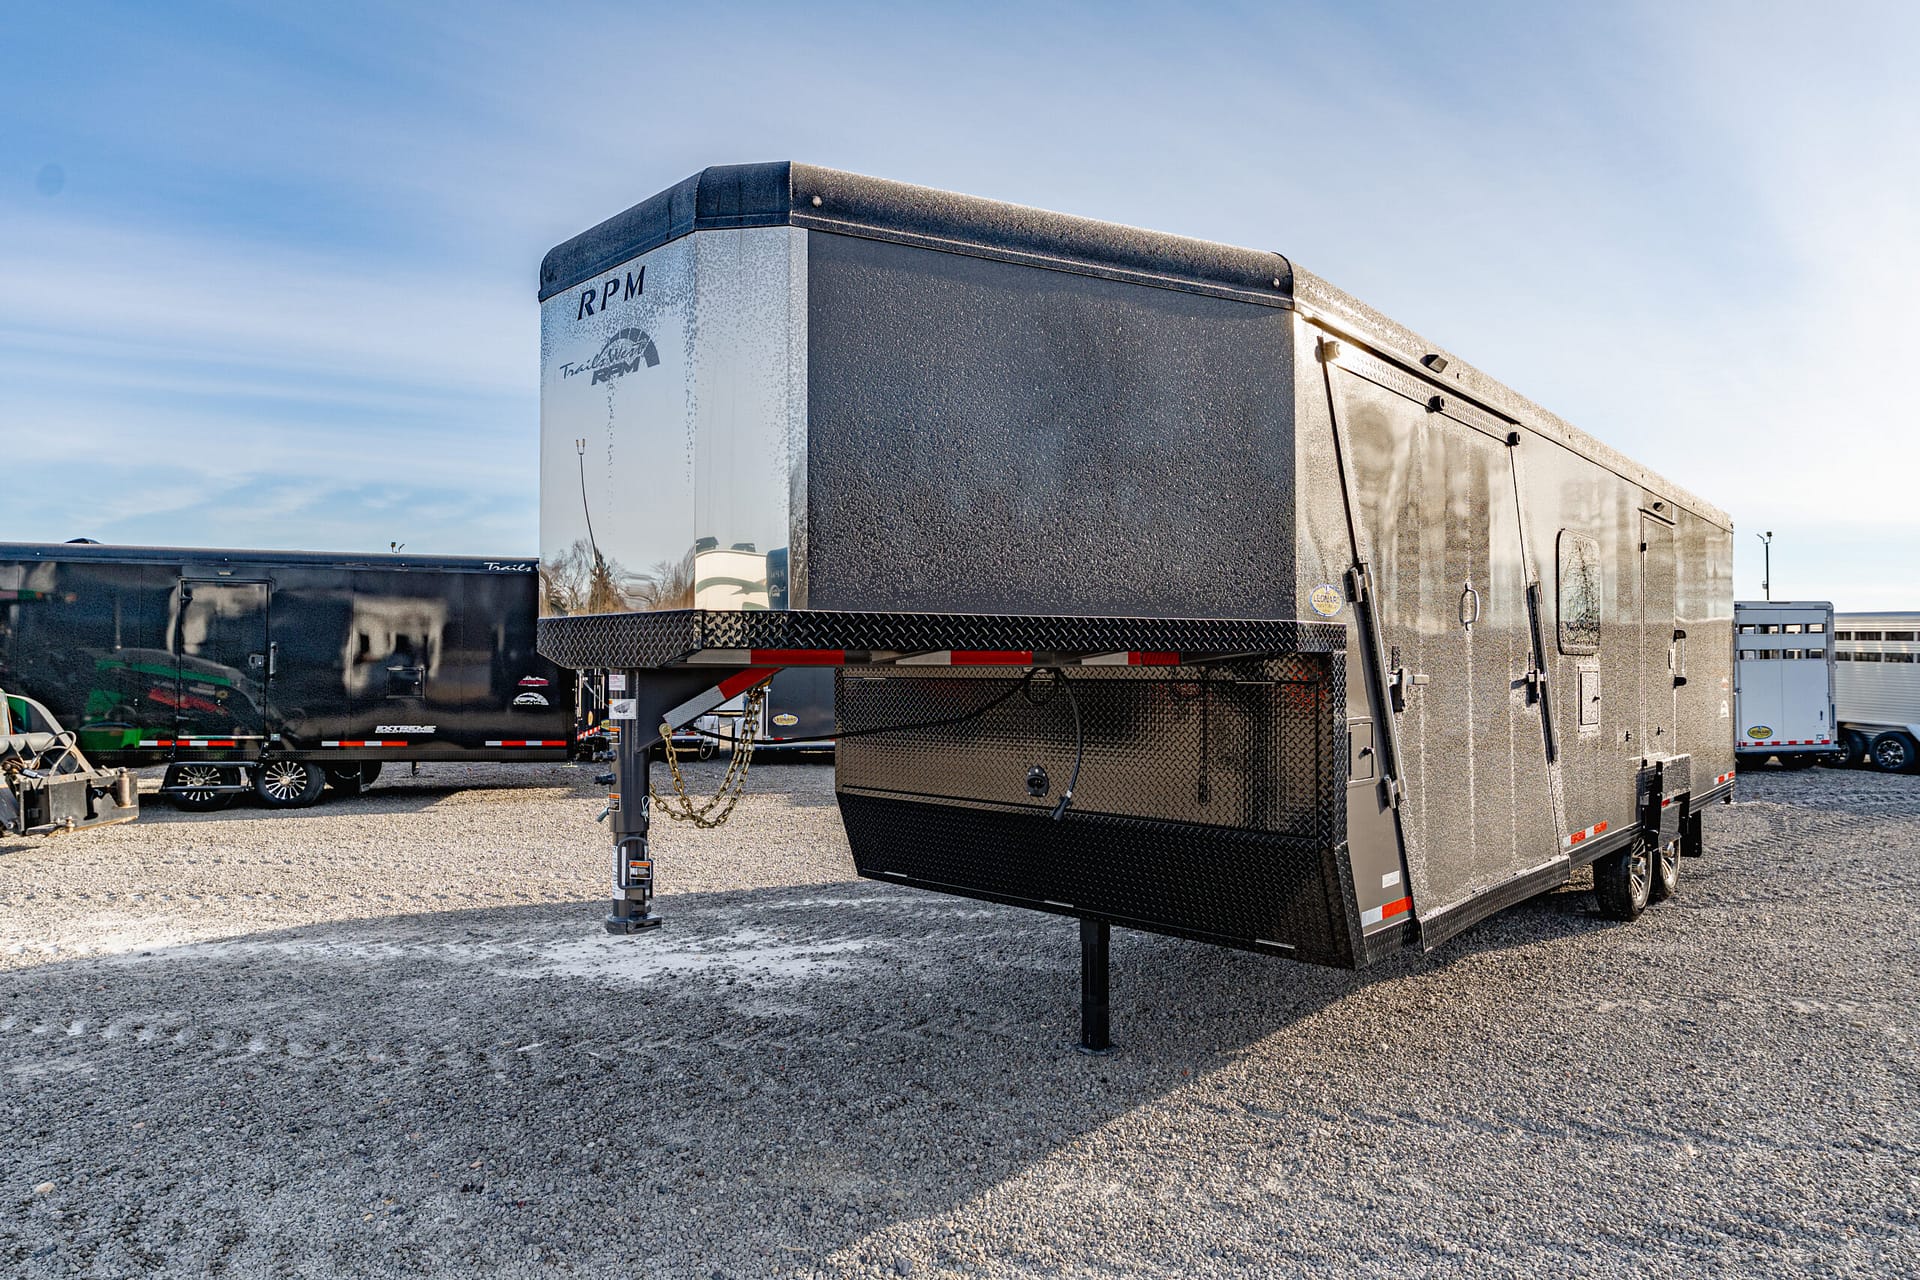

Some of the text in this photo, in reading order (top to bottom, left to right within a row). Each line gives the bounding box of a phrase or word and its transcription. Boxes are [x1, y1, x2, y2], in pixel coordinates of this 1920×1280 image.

[577, 265, 646, 321] RPM
[560, 340, 646, 379] Trails West
[591, 356, 641, 385] RPM
[483, 562, 532, 572] Trails
[1313, 594, 1339, 603] LEONAR
[375, 725, 437, 734] EXTREME
